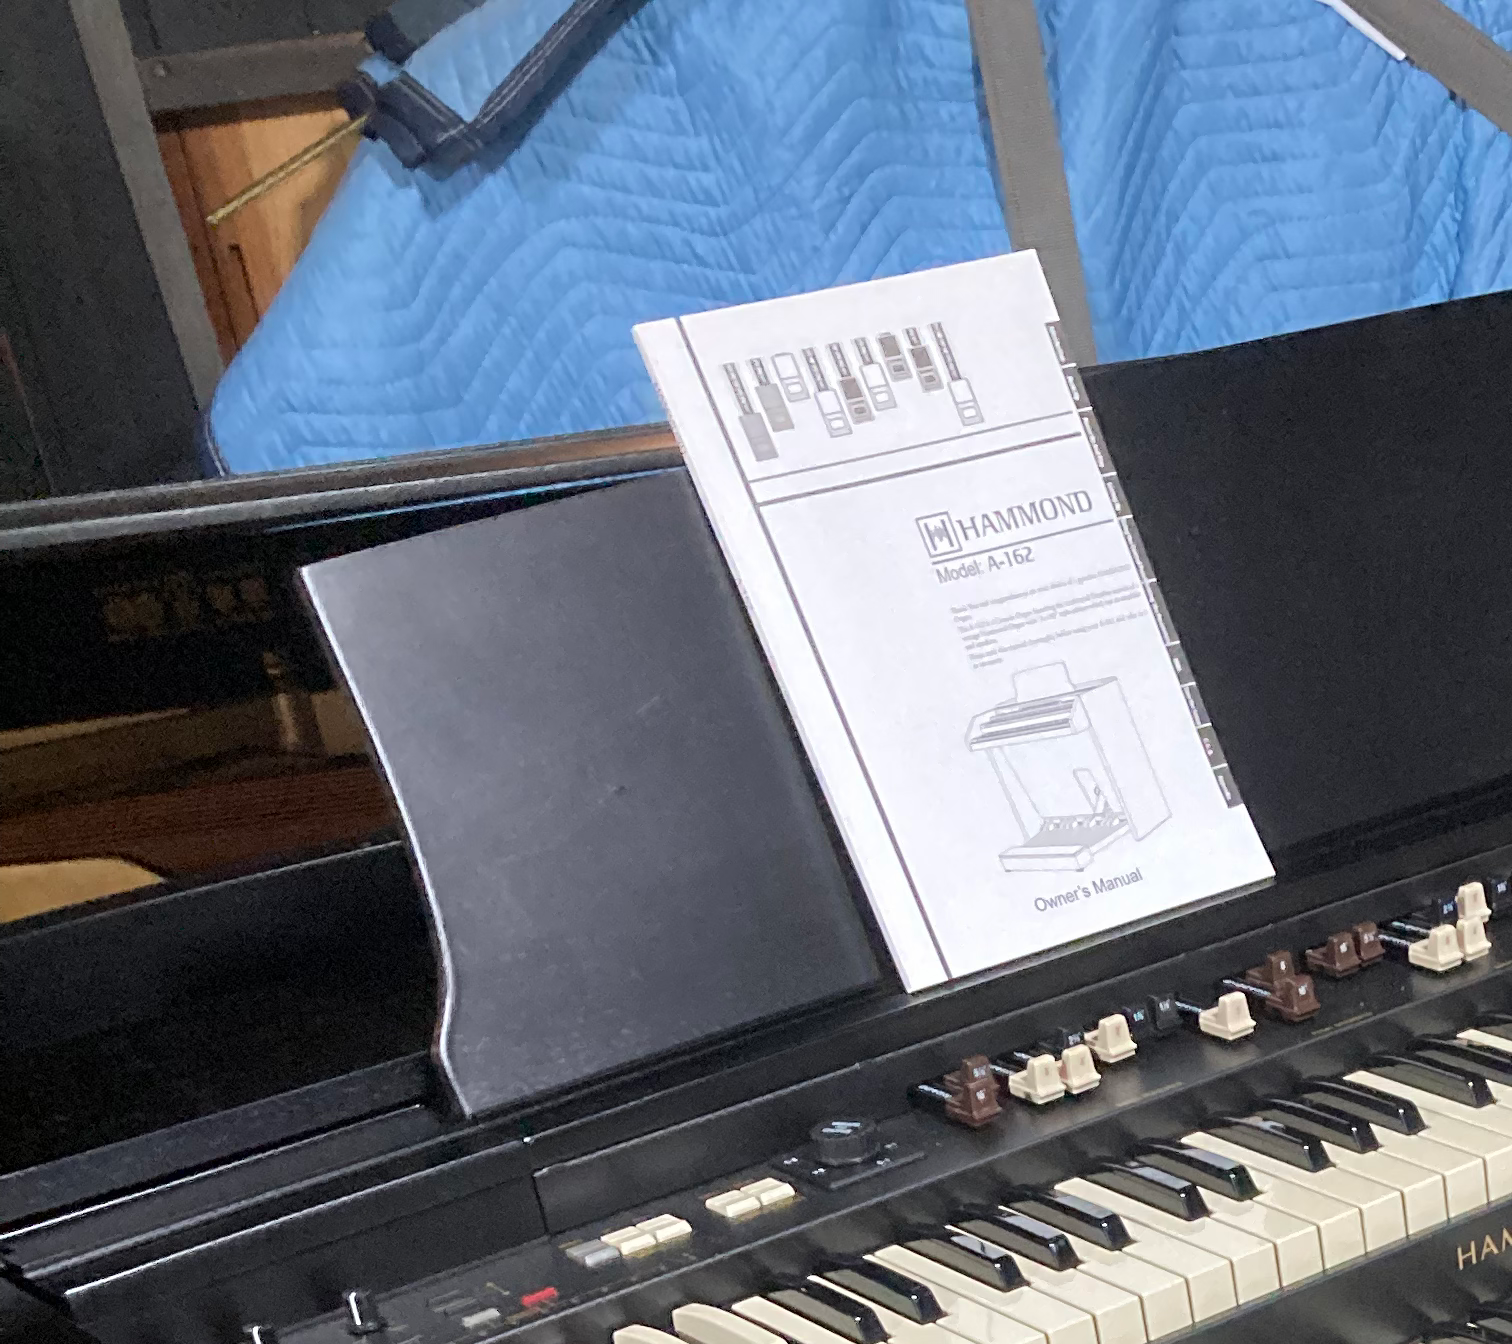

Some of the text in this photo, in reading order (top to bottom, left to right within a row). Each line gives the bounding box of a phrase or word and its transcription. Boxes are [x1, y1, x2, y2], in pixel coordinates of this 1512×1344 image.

[956, 490, 1093, 541] HAMMOND
[936, 546, 1035, 584] Model: A-162
[1034, 867, 1143, 912] Owner's Manual
